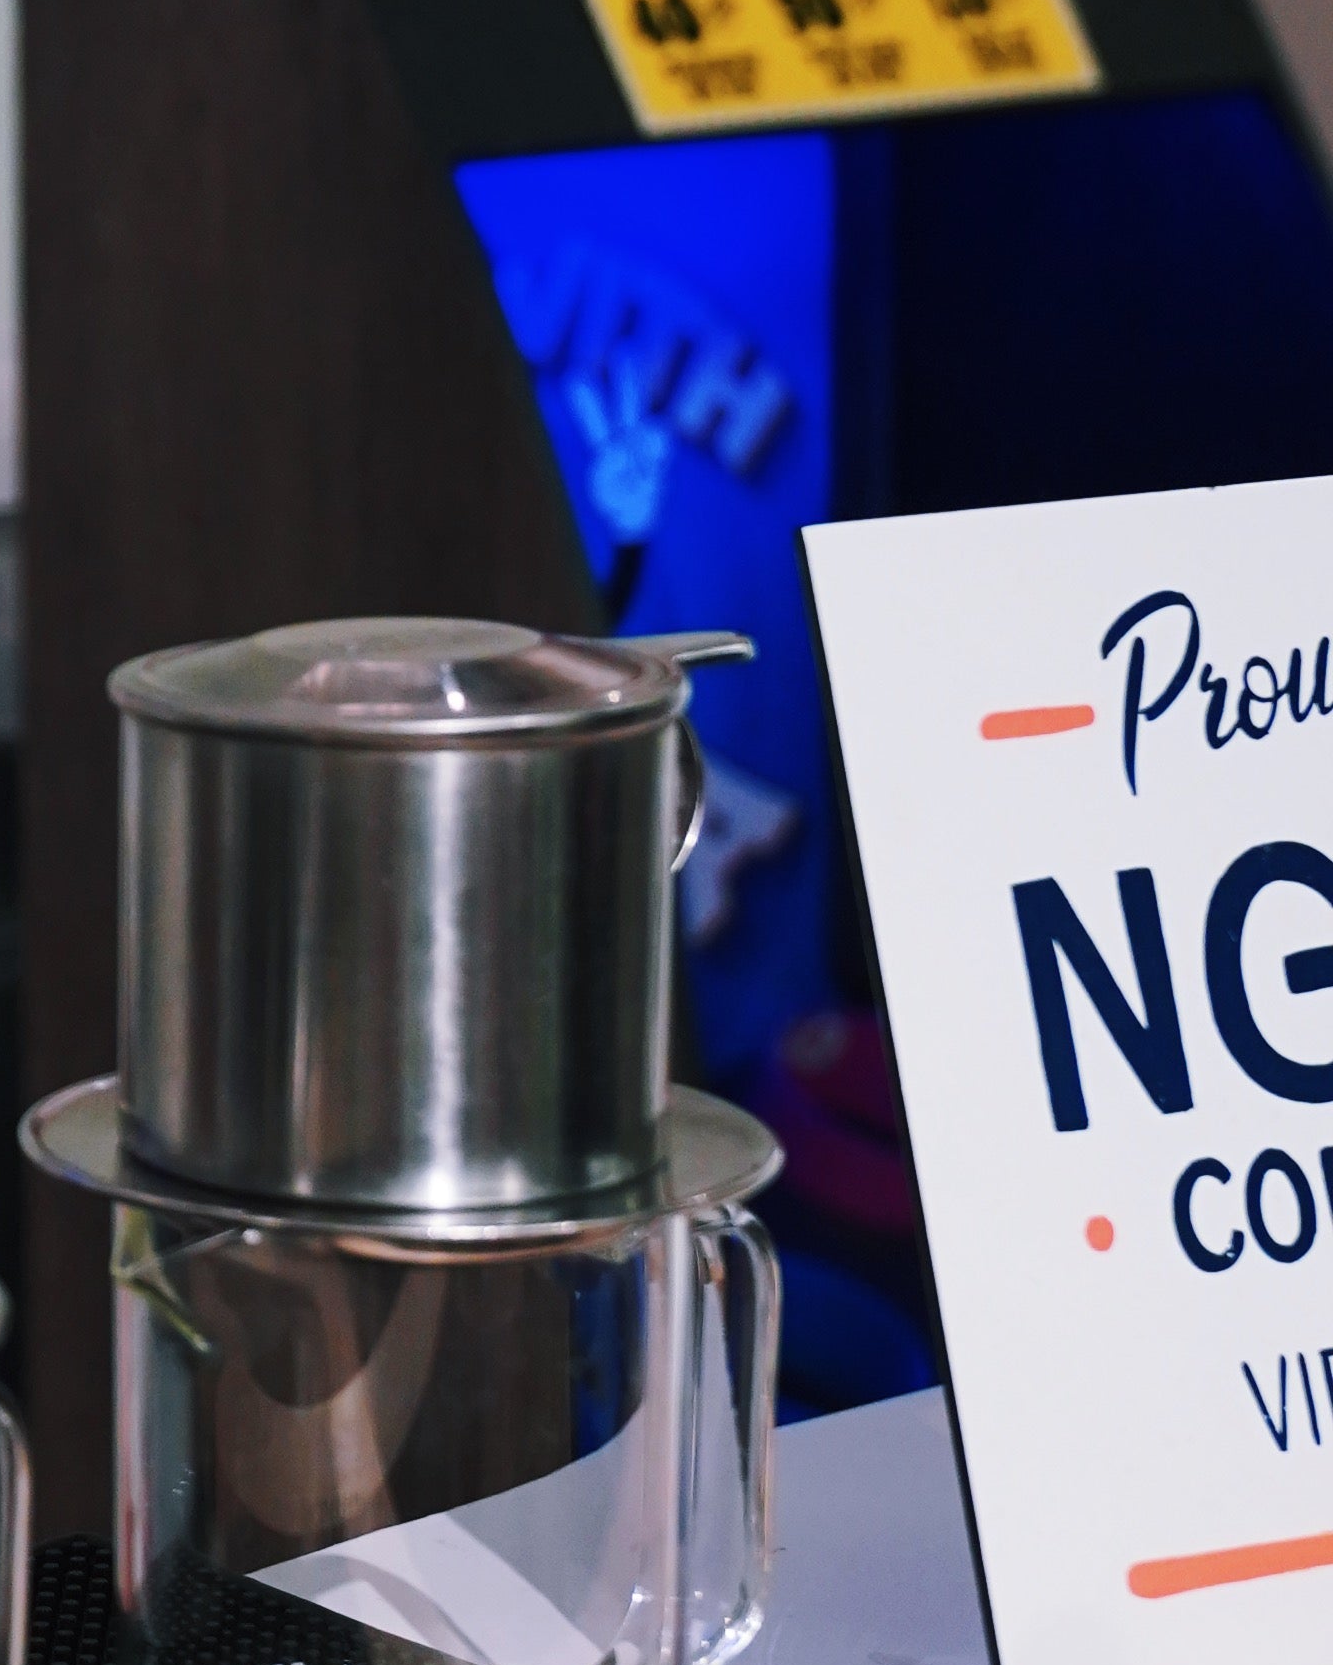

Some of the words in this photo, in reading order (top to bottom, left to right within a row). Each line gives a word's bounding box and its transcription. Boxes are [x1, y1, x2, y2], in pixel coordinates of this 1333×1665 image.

[1101, 590, 1333, 796] Prou
[1011, 840, 1333, 1132] NG
[1173, 1146, 1333, 1273] CO
[1241, 1347, 1333, 1452] VI
